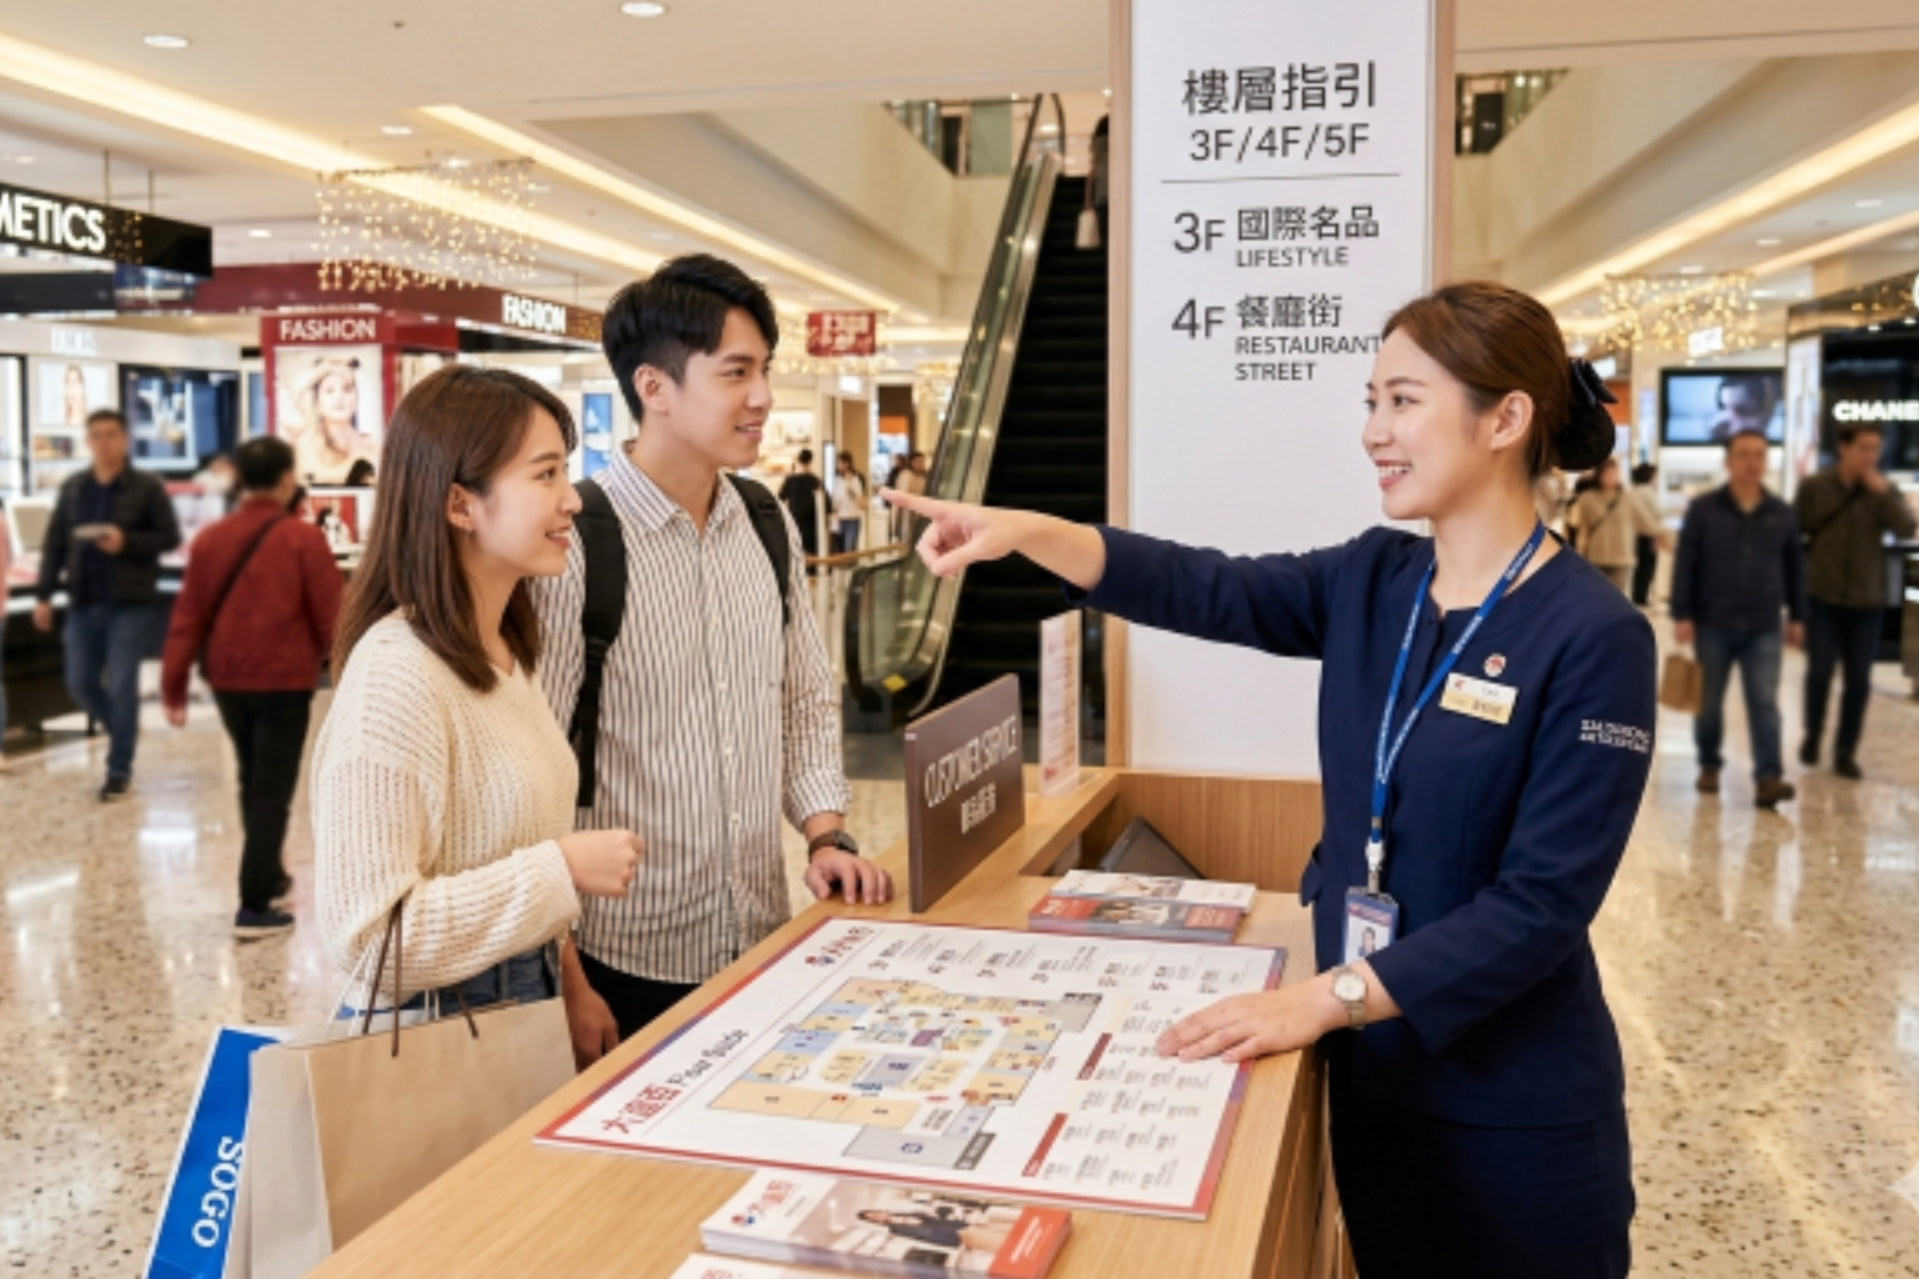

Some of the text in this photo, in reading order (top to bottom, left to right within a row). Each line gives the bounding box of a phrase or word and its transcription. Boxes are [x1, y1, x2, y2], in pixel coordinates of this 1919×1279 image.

[1182, 60, 1376, 116] 樓層指引
[1189, 123, 1370, 162] 3F/4F/5F
[1172, 205, 1379, 253] 3F 國際名品
[1236, 246, 1350, 267] LIFESTYLE
[279, 319, 376, 342] FASHION
[503, 293, 567, 334] FASHION
[1171, 294, 1343, 339] 4F 餐廳街
[1235, 335, 1380, 354] RESTAURANT
[1234, 362, 1318, 381] STREET
[191, 1136, 244, 1248] SOGO
